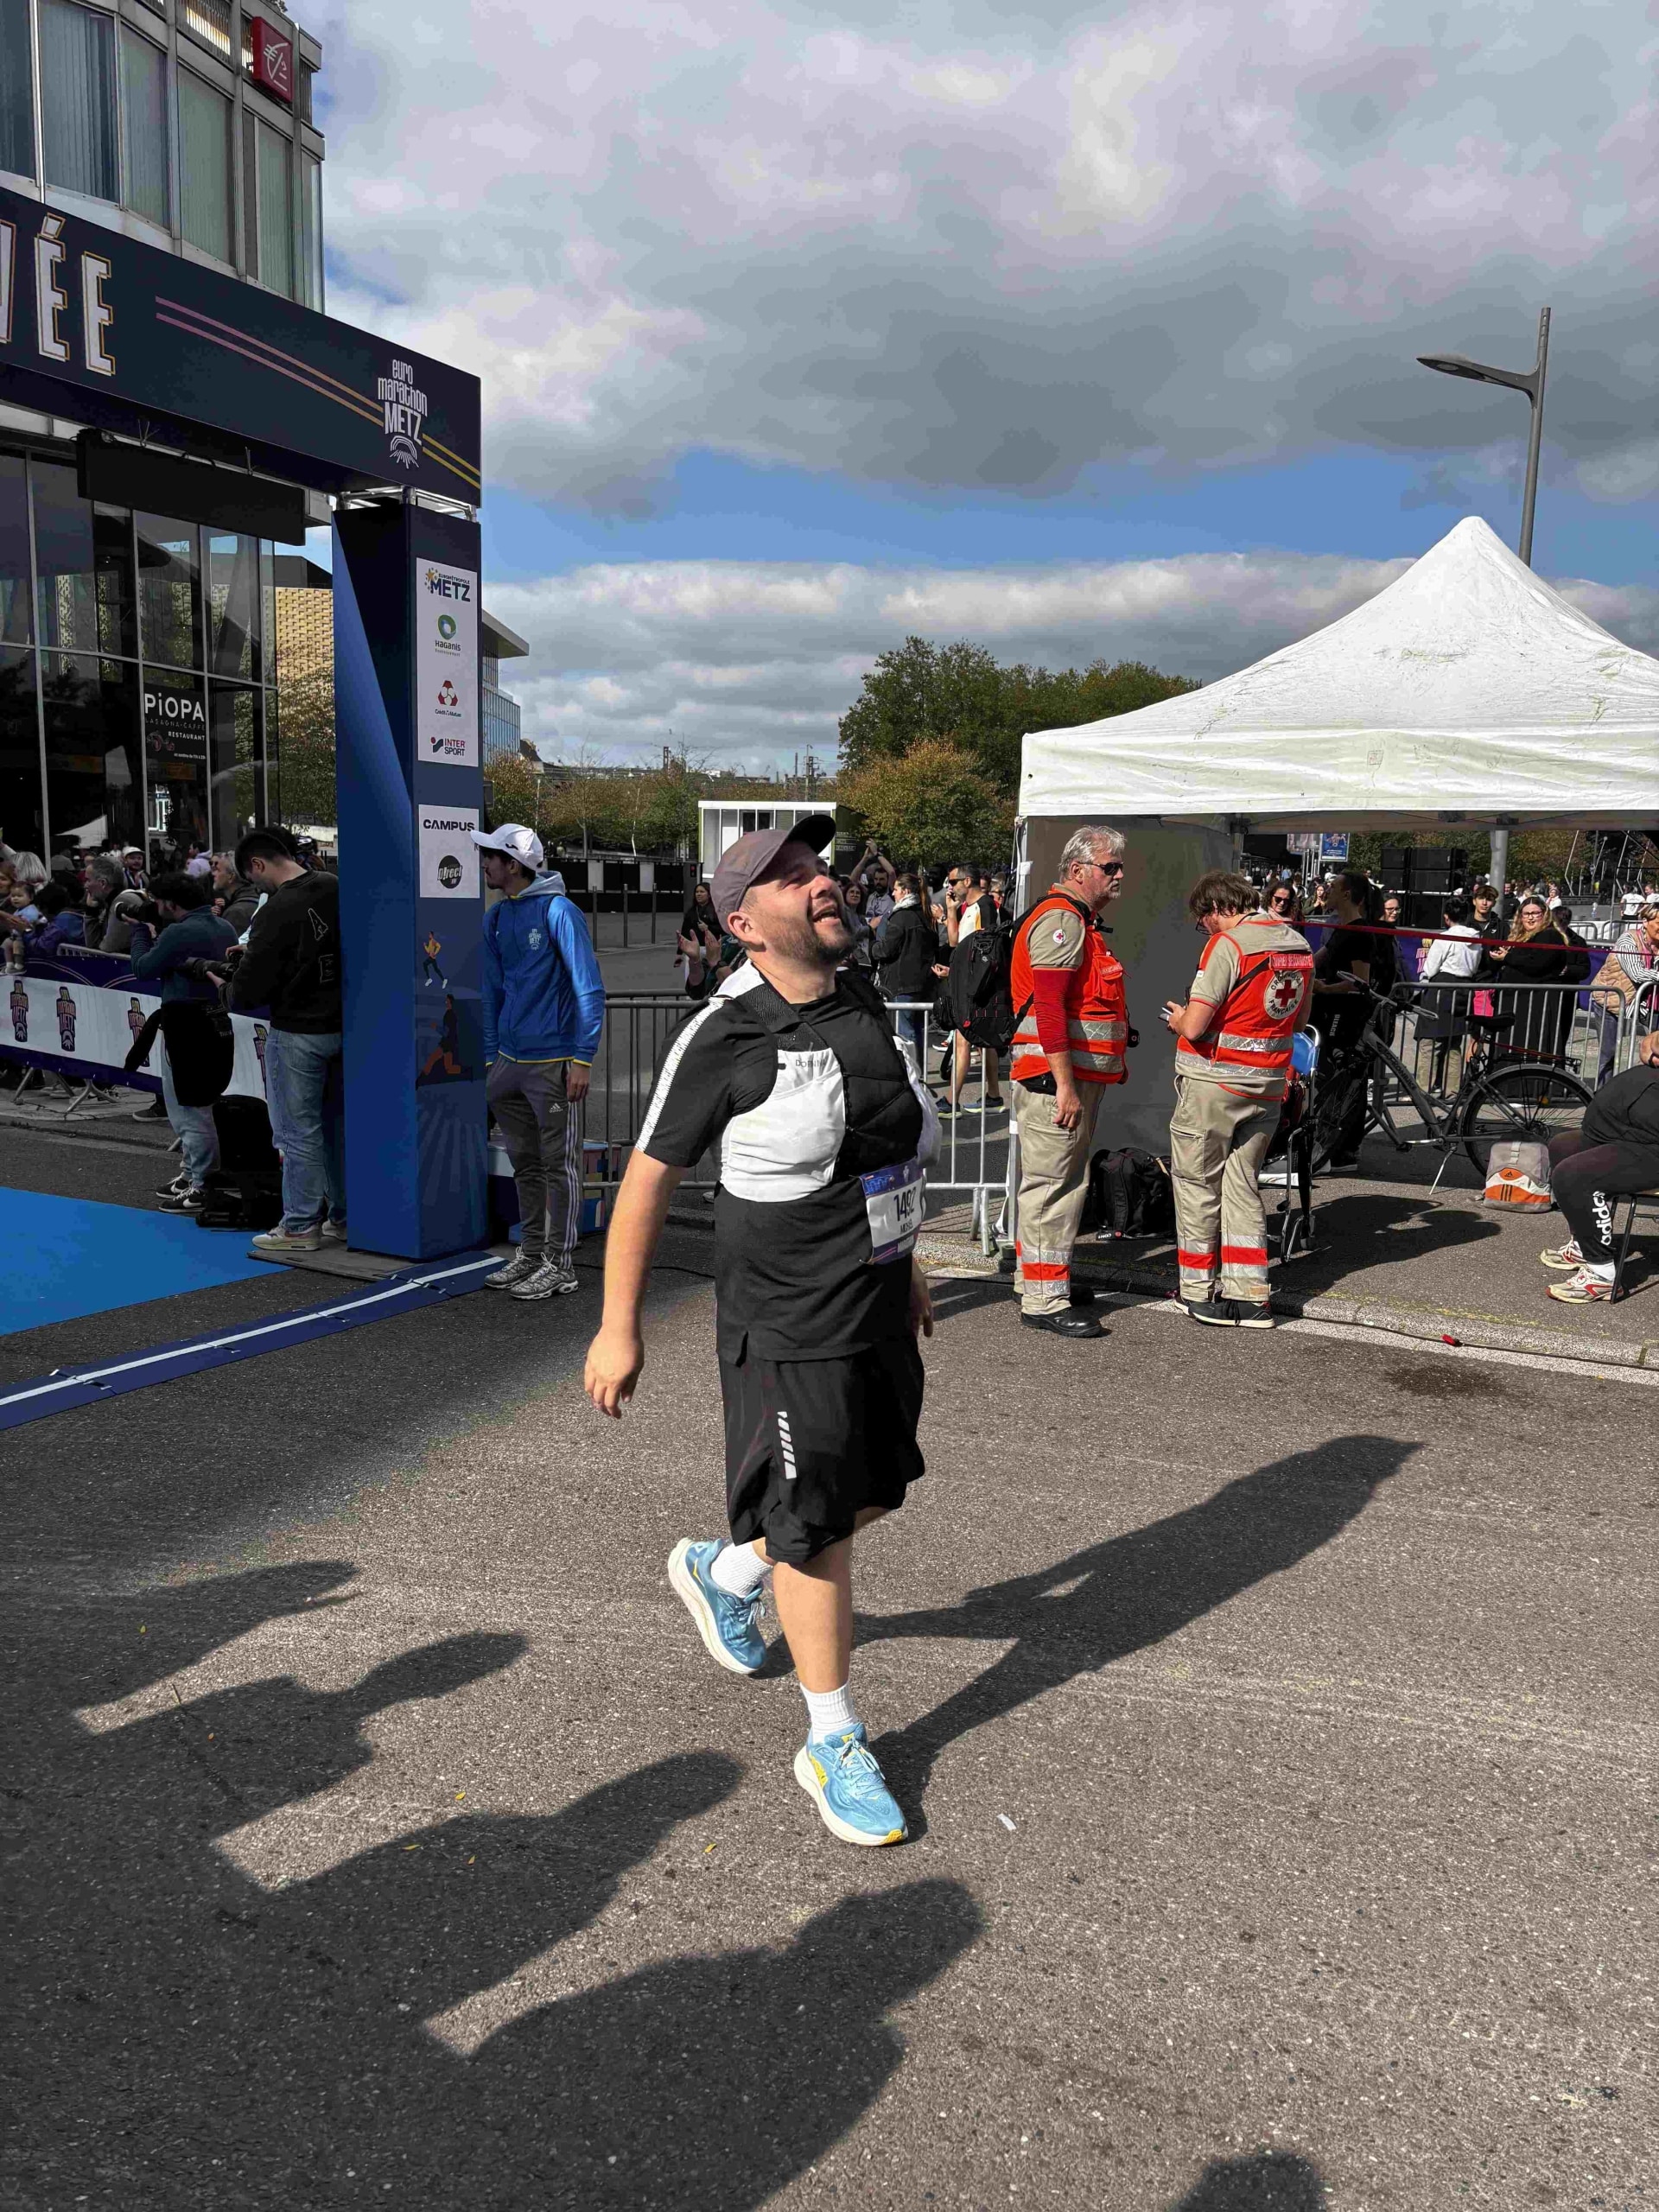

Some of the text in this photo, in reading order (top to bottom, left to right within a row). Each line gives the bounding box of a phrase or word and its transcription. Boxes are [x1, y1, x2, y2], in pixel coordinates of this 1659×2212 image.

[392, 359, 413, 385] euro
[378, 377, 428, 417] marathon
[385, 402, 422, 446] METZ
[430, 578, 471, 602] METZ
[168, 731, 206, 741] RESTAURANT
[444, 738, 466, 748] INTER
[444, 747, 466, 756] SPORT
[423, 819, 475, 832] CAMPUS
